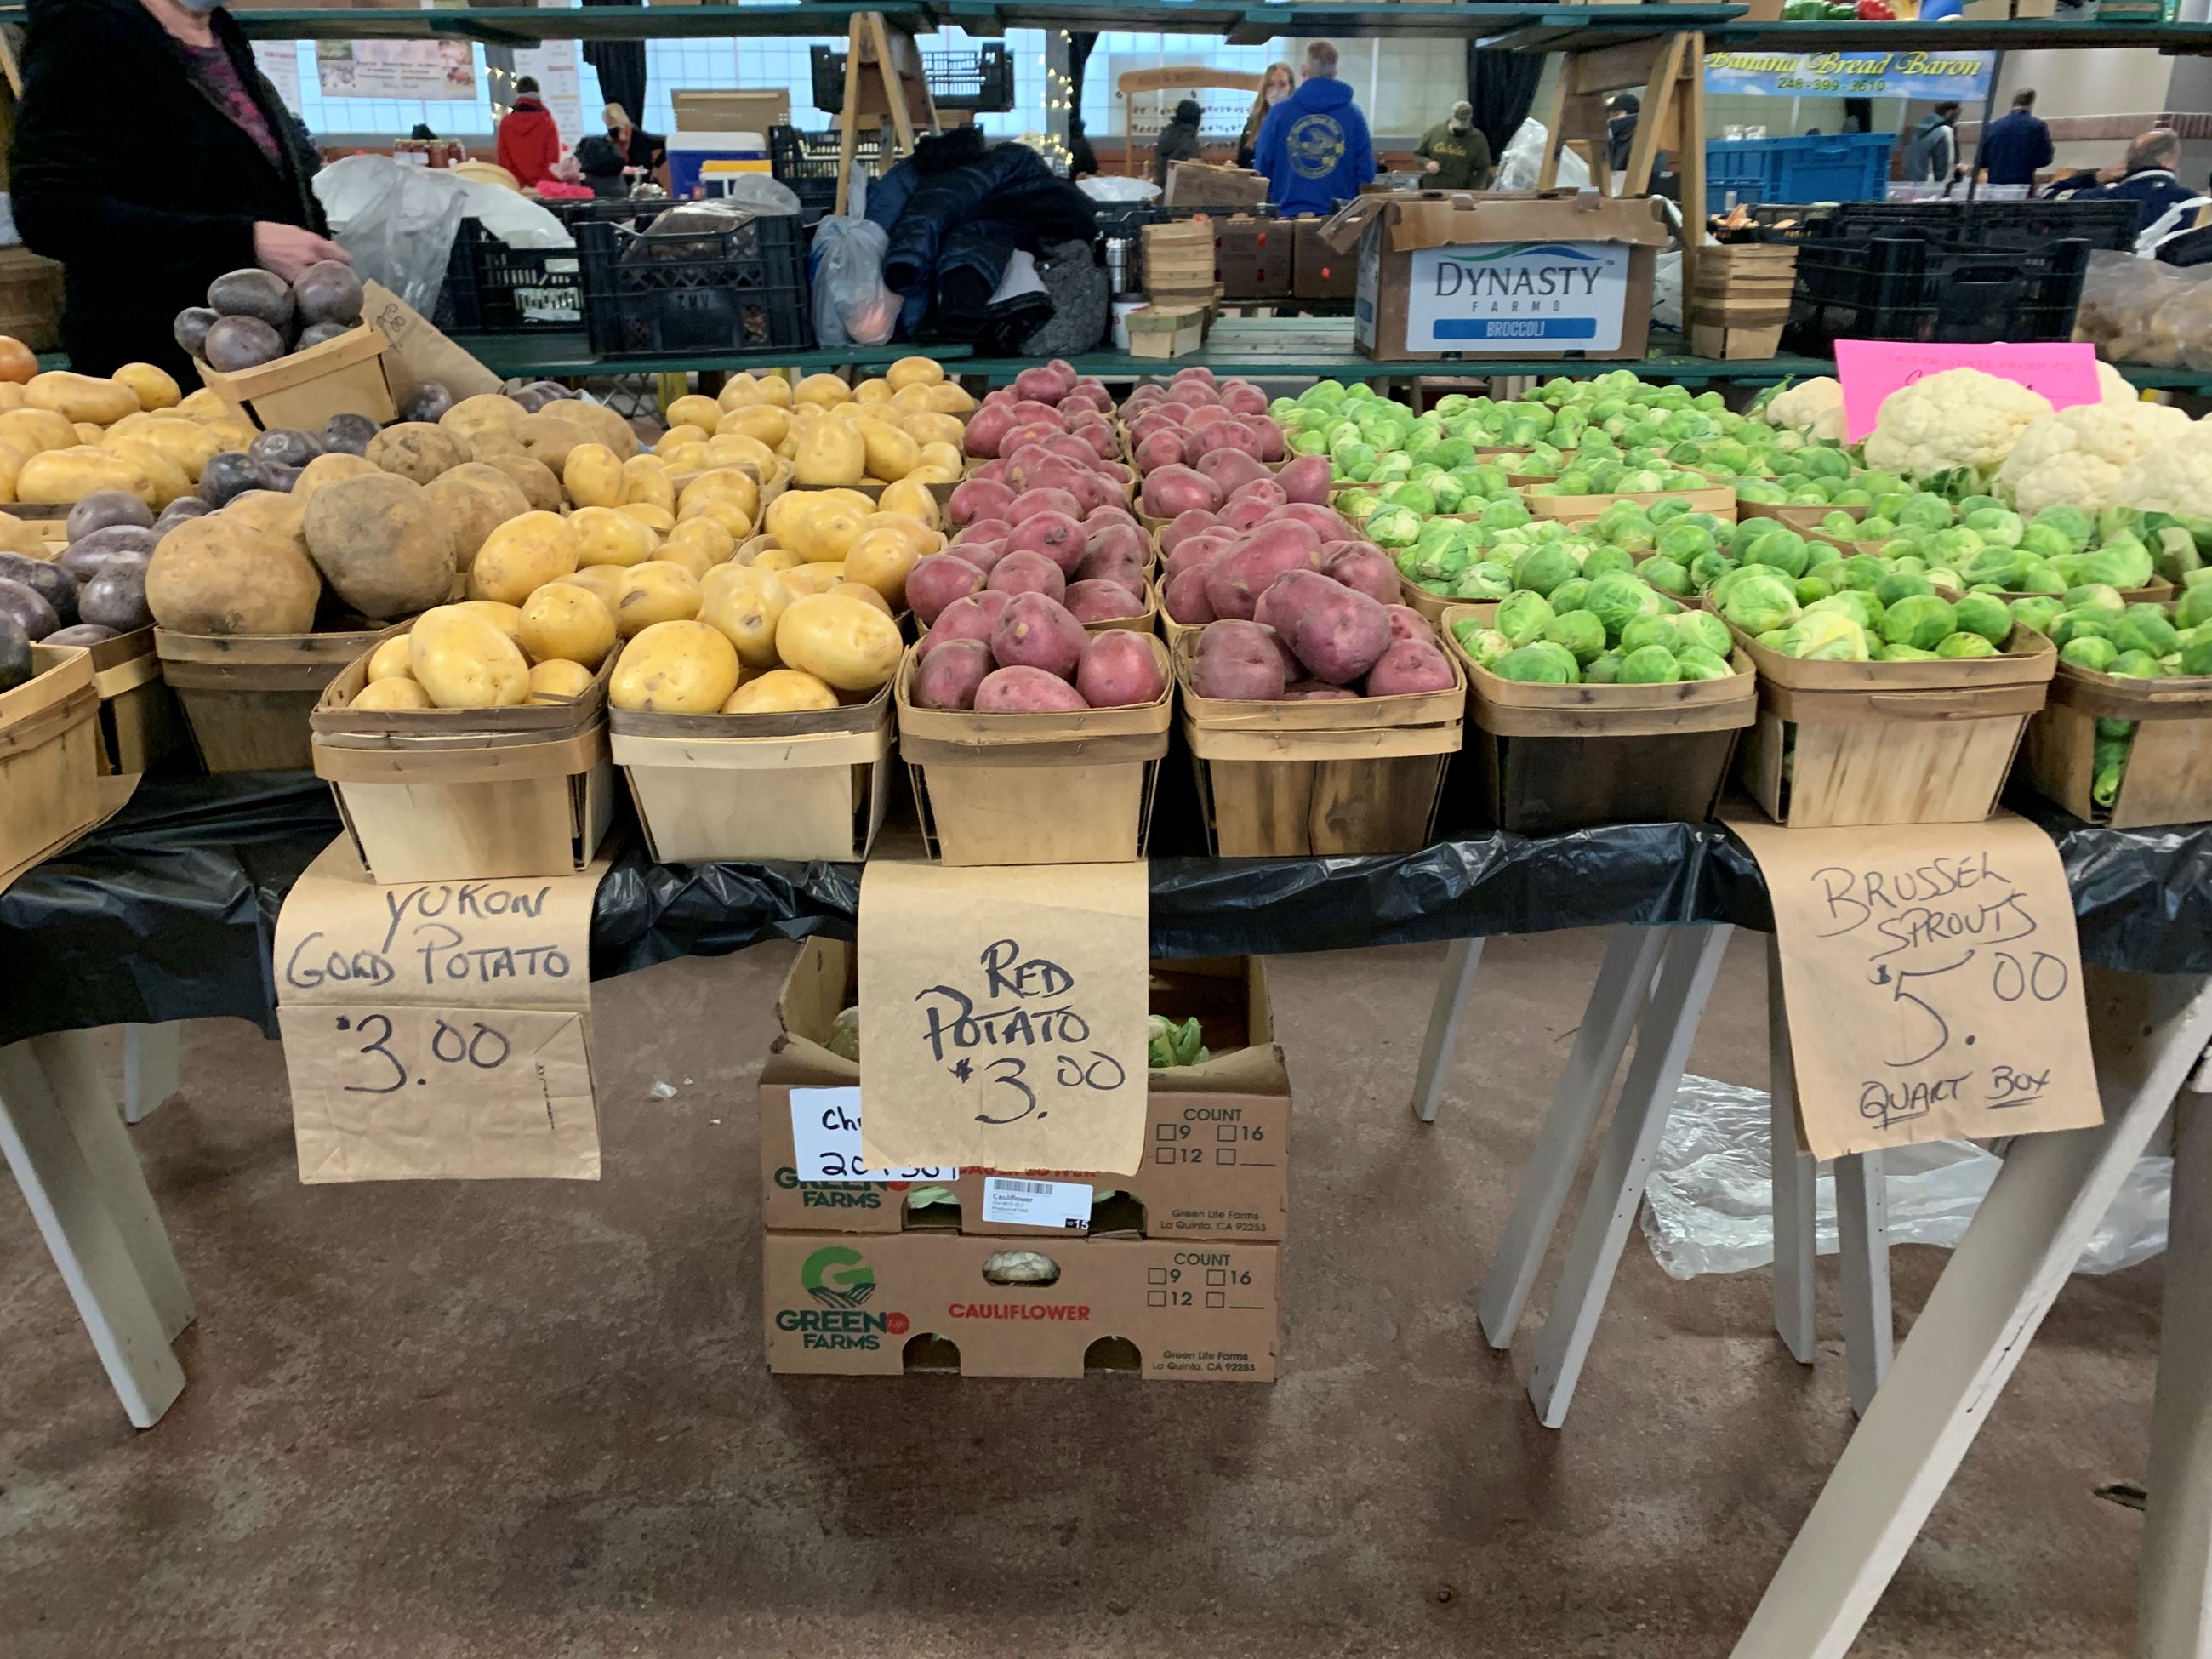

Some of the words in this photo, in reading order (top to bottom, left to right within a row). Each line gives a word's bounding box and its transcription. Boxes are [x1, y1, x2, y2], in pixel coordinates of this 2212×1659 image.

[1702, 52, 1799, 73] Banana
[1806, 51, 1894, 76] Bread
[1895, 51, 1981, 77] Baron
[1435, 261, 1603, 296] DYNASTY
[1472, 299, 1561, 313] FARMS
[1486, 321, 1545, 337] BROCCOLI
[1810, 851, 2011, 938] BRUSSEL
[381, 882, 551, 955] YUKON
[1868, 887, 2038, 962] SPROUTS
[285, 931, 396, 989] GOLD
[412, 922, 571, 985] POTATO
[980, 938, 1075, 999] RED
[914, 984, 1091, 1062] POTATO
[1859, 1070, 1974, 1130] QUART
[1984, 1065, 2050, 1101] BOX
[1183, 1109, 1243, 1121] COUNT
[1179, 1125, 1191, 1139] 9
[1241, 1126, 1264, 1141] 16
[1181, 1149, 1203, 1163] 12
[802, 1191, 881, 1209] FARMS
[992, 1193, 1034, 1204] Cauliflower
[1172, 1209, 1205, 1218] Green
[1207, 1210, 1225, 1218] Life
[1228, 1211, 1259, 1220] Farms
[1075, 1219, 1089, 1230] 15
[1160, 1221, 1173, 1229] La
[1217, 1222, 1232, 1230] CA
[1235, 1223, 1267, 1232] 92253
[1174, 1252, 1231, 1266] COUNT
[1169, 1268, 1182, 1283] 9
[1230, 1270, 1251, 1285] 16
[1171, 1291, 1192, 1306] 12
[948, 1303, 1091, 1321] CAULIFLOWER
[774, 1309, 887, 1334] GREEN
[802, 1333, 881, 1351] FARMS
[1163, 1350, 1195, 1360] Green
[1198, 1350, 1215, 1360] Life
[1217, 1351, 1249, 1361] Farms
[1206, 1363, 1223, 1371] CA
[1225, 1363, 1256, 1372] 92253
